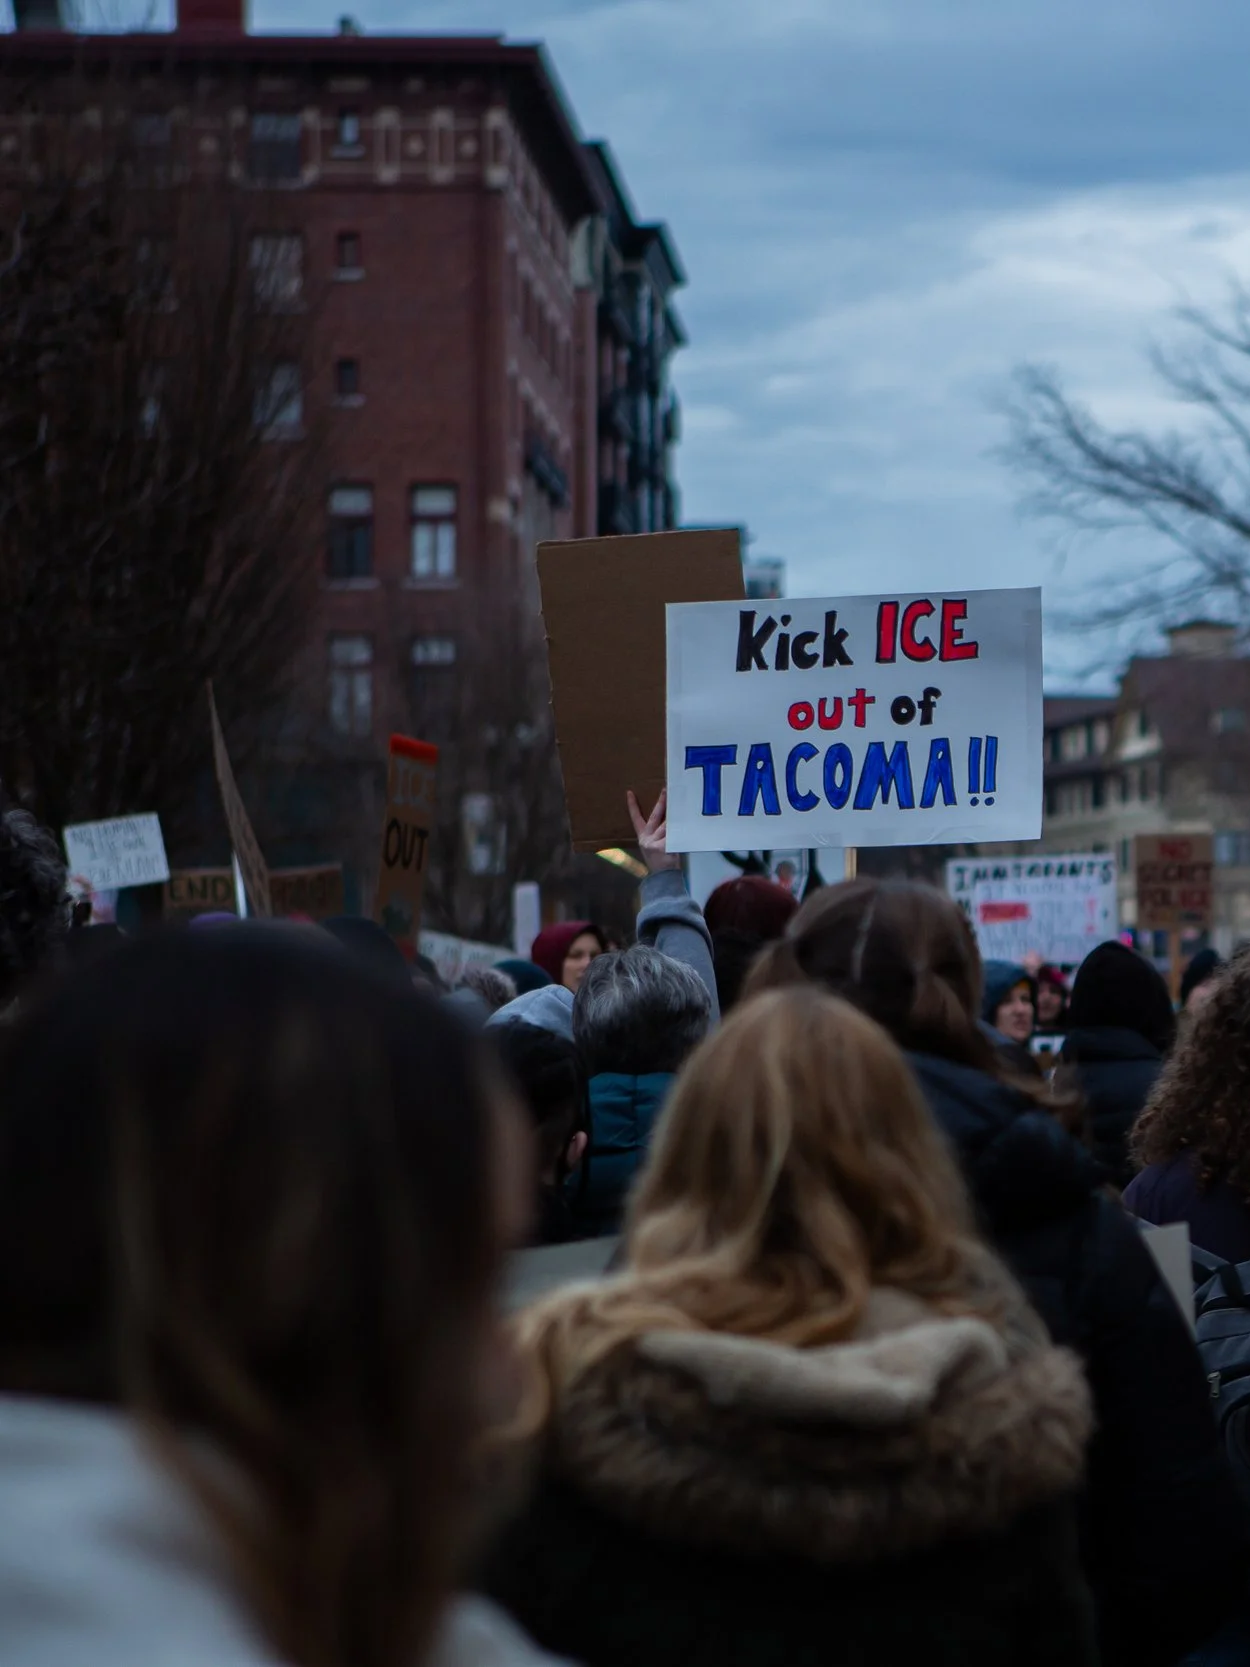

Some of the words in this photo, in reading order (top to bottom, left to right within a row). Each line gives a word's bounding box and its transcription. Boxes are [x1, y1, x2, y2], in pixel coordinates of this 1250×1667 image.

[736, 609, 854, 673] Kick
[875, 598, 979, 664] ICE
[787, 688, 876, 730] out
[890, 686, 942, 726] of
[684, 735, 999, 817] TACOMA!!
[384, 818, 429, 872] OUT
[1159, 840, 1191, 859] NO
[169, 874, 231, 903] END
[1137, 862, 1213, 883] SECRET
[1138, 887, 1211, 908] POLICE
